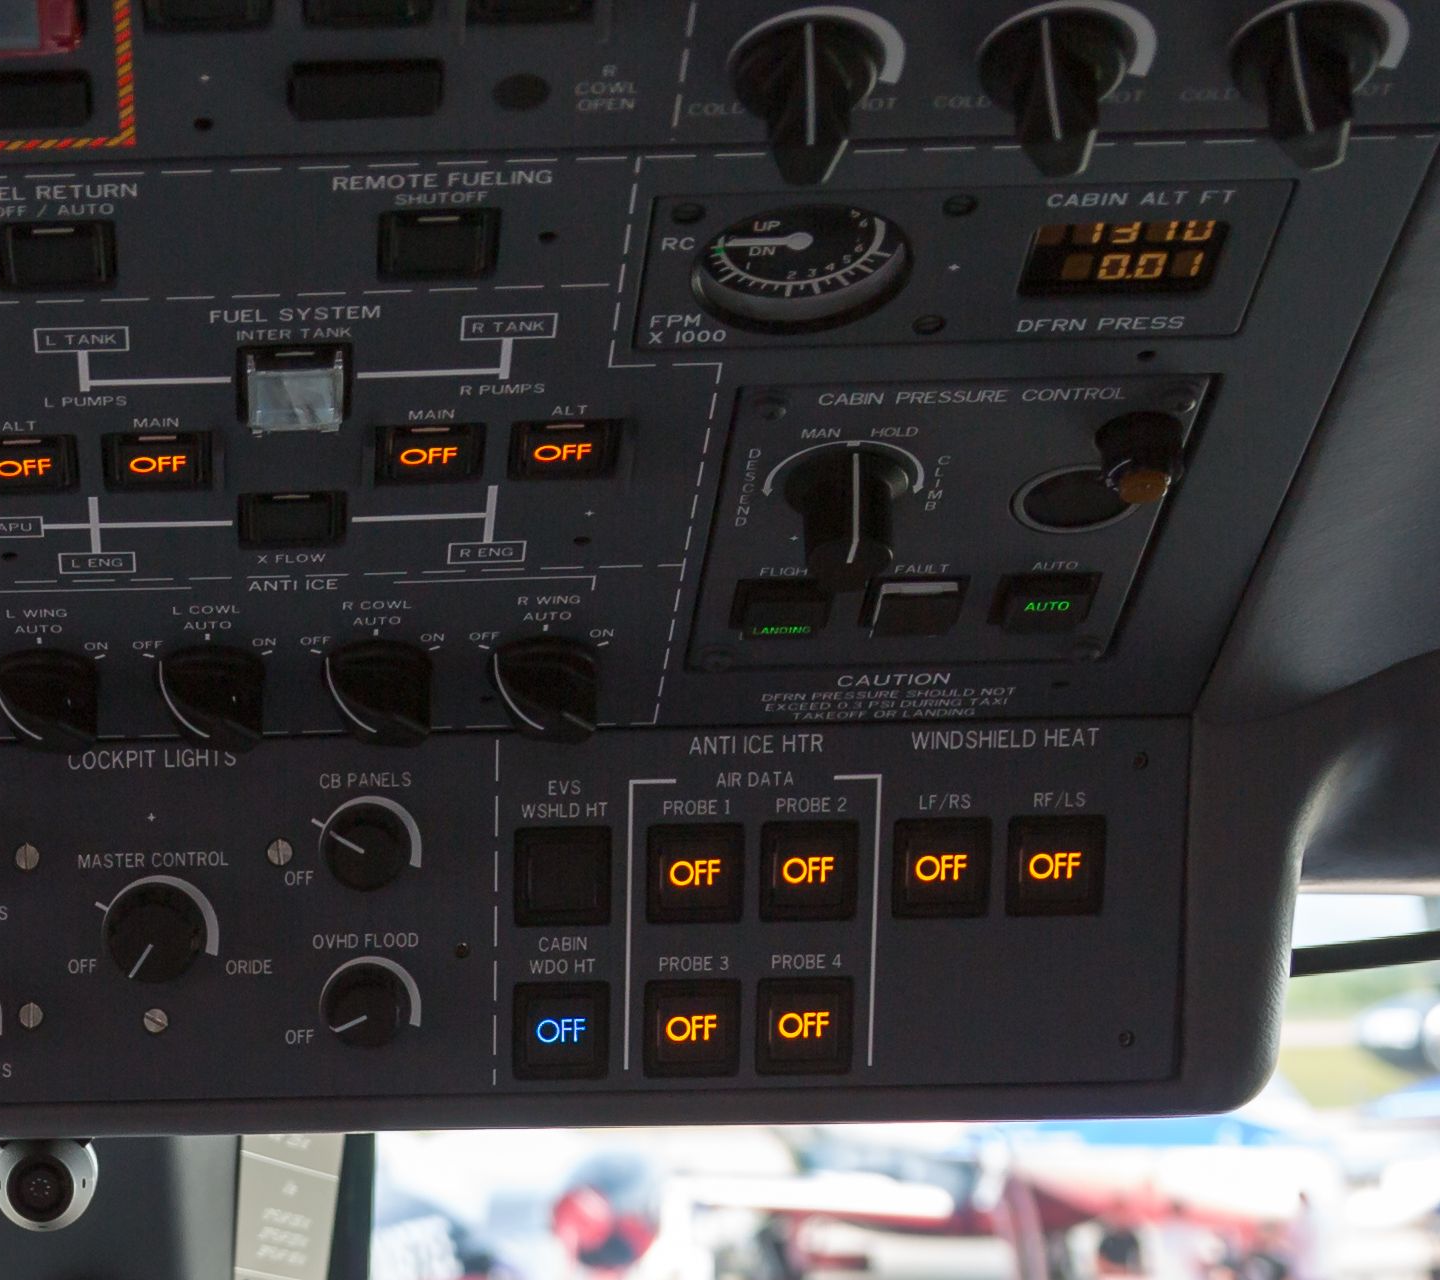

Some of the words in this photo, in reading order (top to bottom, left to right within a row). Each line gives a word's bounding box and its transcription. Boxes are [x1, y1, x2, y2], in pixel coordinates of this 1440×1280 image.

[331, 173, 438, 192] REMOTE
[447, 169, 553, 187] FUELING
[35, 181, 138, 200] RETURN
[1046, 191, 1127, 210] CABIN
[1139, 190, 1190, 207] ALT
[1199, 188, 1237, 205] FT
[660, 237, 696, 252] RC
[209, 307, 268, 325] FUEL
[278, 304, 382, 322] SYSTEM
[649, 314, 701, 329] FPM
[1016, 317, 1087, 334] DFRN
[1097, 314, 1187, 332] PRESS
[471, 320, 485, 334] R
[492, 319, 547, 334] TANK
[45, 334, 57, 347] L
[62, 332, 119, 347] TANK
[648, 330, 663, 345] X
[674, 328, 727, 344] 1000
[817, 392, 886, 407] CABIN
[894, 389, 1009, 405] PRESSURE
[1021, 387, 1127, 403] CONTROL
[408, 408, 456, 421] MAIN
[551, 404, 588, 417] ALT
[1, 419, 37, 432] ALT
[133, 416, 180, 429] MAIN
[870, 426, 919, 438] HOLD
[800, 428, 842, 440] MAN
[399, 446, 459, 467] OFF
[532, 442, 593, 463] OFF
[128, 454, 188, 475] OFF
[1031, 560, 1079, 571] AUTO
[248, 578, 299, 593] ANTI
[304, 578, 339, 591] ICE
[1024, 600, 1071, 613] AUTO
[836, 672, 952, 687] CAUTION
[688, 734, 738, 756] ANTI
[741, 734, 774, 755] ICE
[778, 733, 824, 755] HTR
[911, 728, 1037, 752] WINDSHIELD
[1042, 727, 1100, 749] HEAT
[67, 749, 157, 772] COCKPIT
[163, 747, 238, 770] LIGHTS
[318, 773, 343, 790] CB
[346, 771, 412, 789] PANELS
[662, 799, 716, 817] PROBE
[724, 799, 732, 816] 1
[775, 797, 832, 815] PROBE
[837, 796, 848, 814] 2
[917, 792, 973, 812] LF/RS
[1032, 790, 1087, 810] RF/LS
[77, 852, 145, 870] MASTER
[150, 851, 229, 869] CONTROL
[781, 854, 836, 885] OFF
[913, 853, 968, 883] OFF
[1026, 850, 1082, 882] OFF
[667, 858, 722, 888] OFF
[311, 933, 359, 951] OVHD
[363, 931, 419, 949] FLOOD
[224, 959, 273, 975] ORIDE
[534, 1016, 587, 1044] OFF
[664, 1014, 719, 1043] OFF
[777, 1011, 831, 1040] OFF
